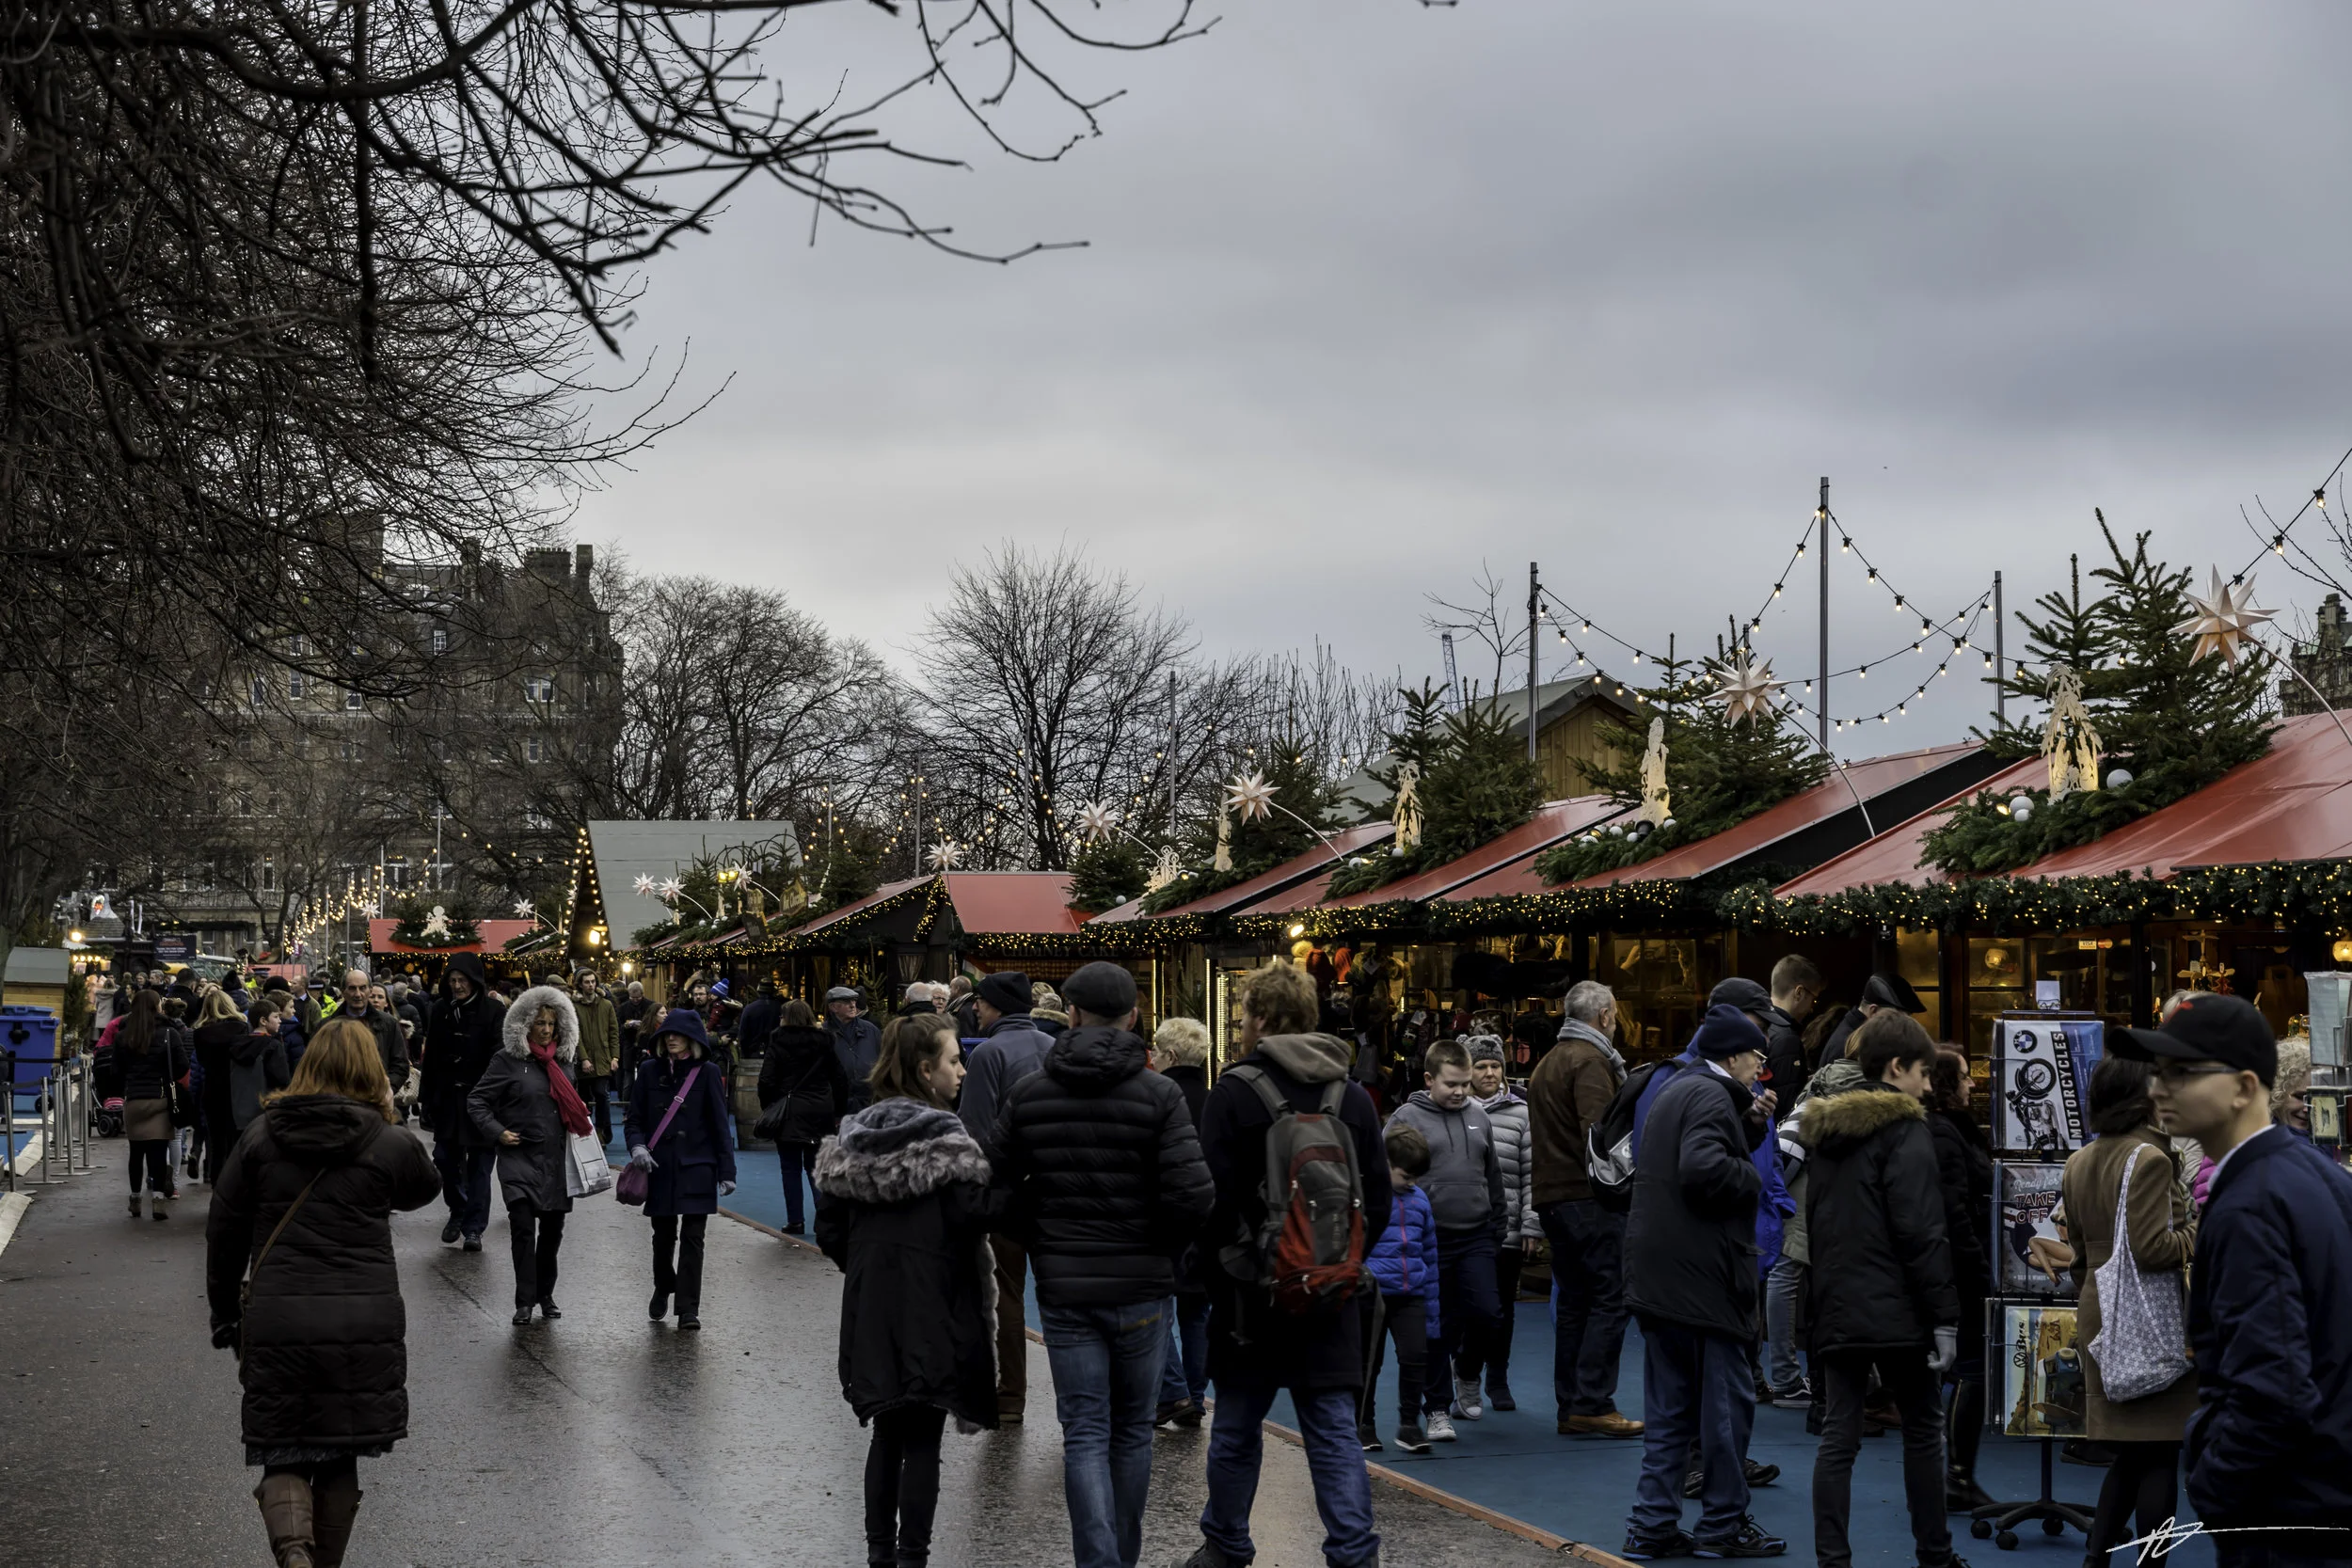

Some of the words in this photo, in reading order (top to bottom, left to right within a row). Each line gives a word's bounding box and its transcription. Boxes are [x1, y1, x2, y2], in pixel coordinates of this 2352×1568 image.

[1002, 945, 1072, 958] CHIMNEY
[1078, 945, 1119, 958] CAKE
[2052, 1032, 2084, 1140] MOTORCYCLES
[2013, 1179, 2041, 1192] Ready
[2042, 1176, 2059, 1189] for
[2013, 1191, 2057, 1208] TAKE
[2015, 1208, 2048, 1225] OFF
